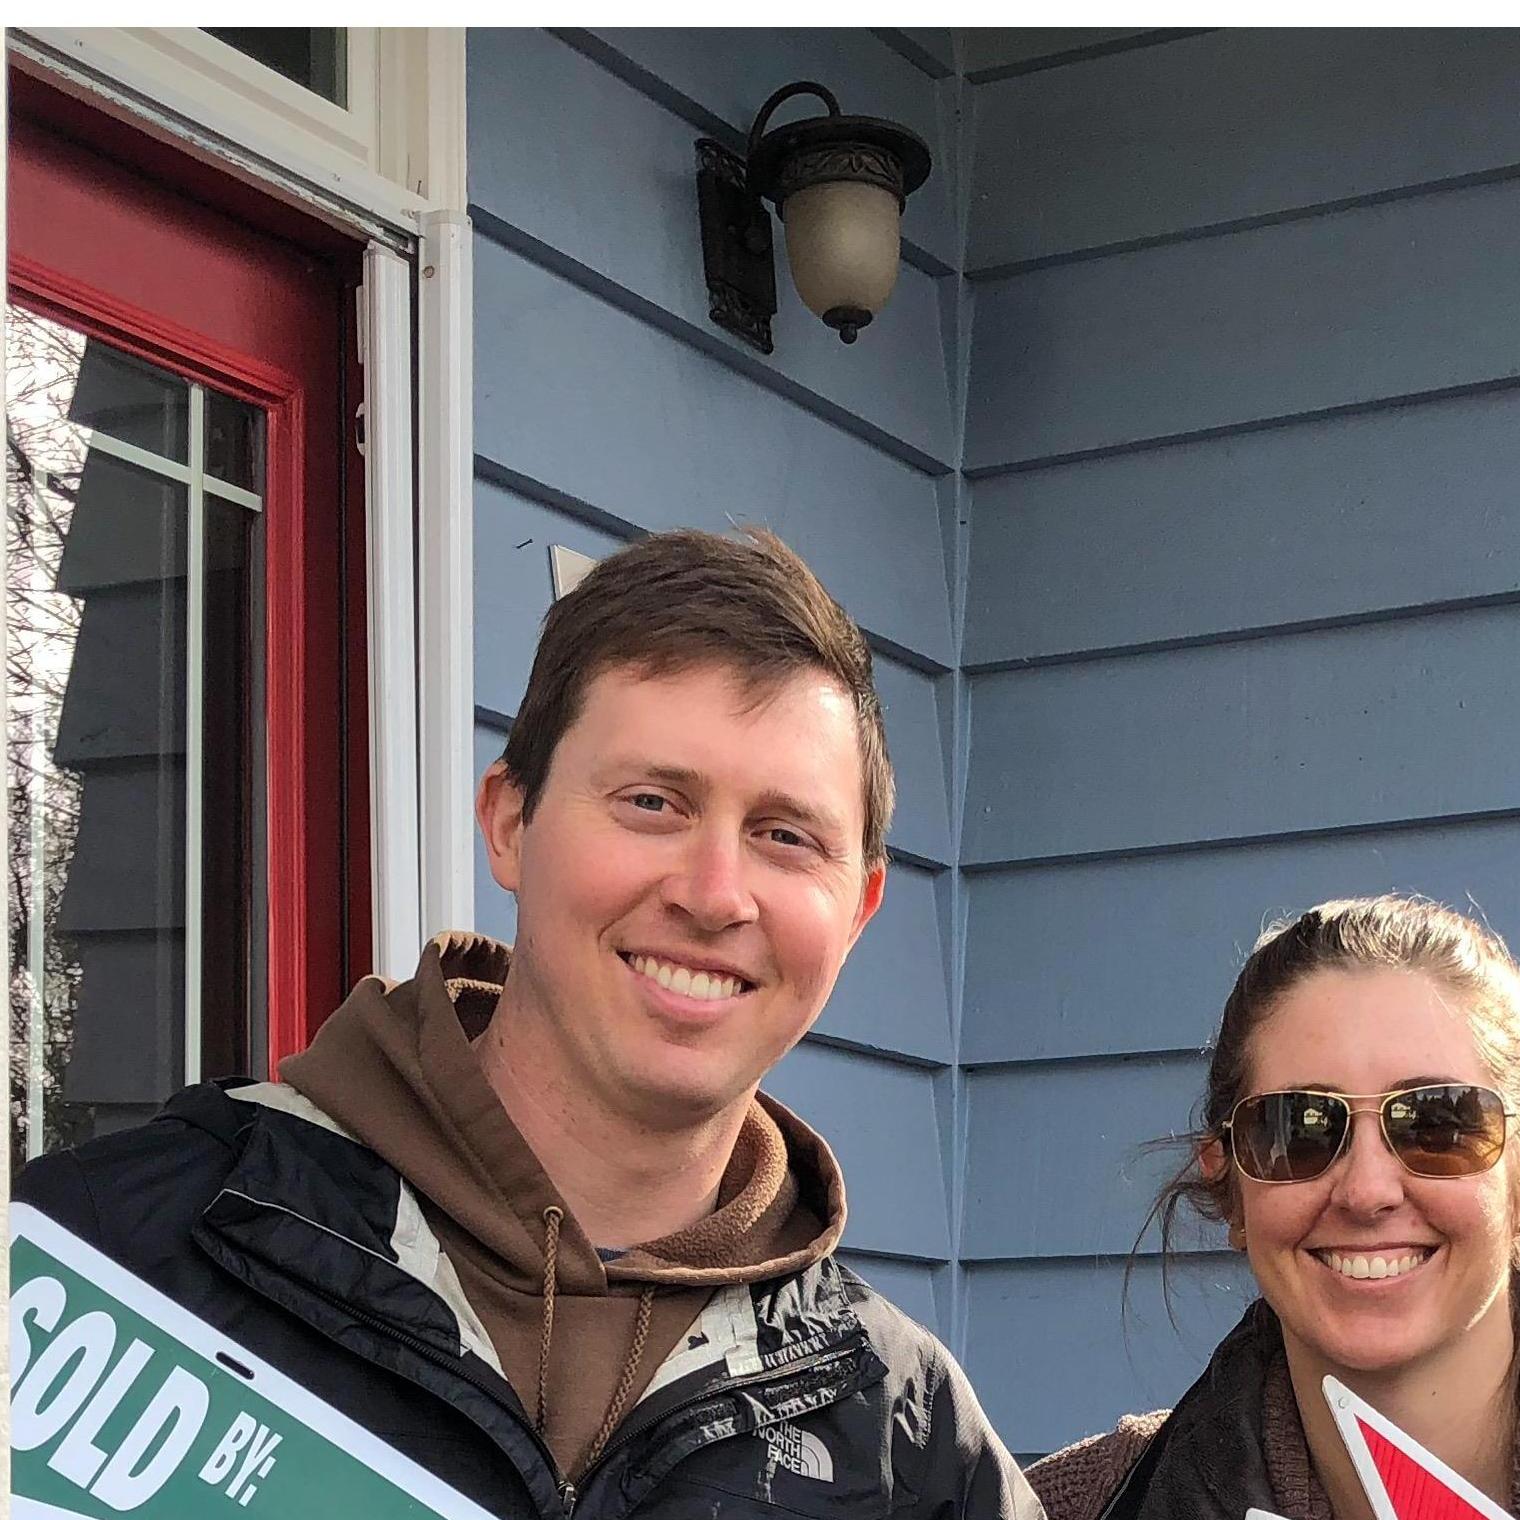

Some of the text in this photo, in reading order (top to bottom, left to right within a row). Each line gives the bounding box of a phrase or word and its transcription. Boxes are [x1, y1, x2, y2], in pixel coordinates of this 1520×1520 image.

[10, 1276, 283, 1511] SOLD BY:
[767, 1443, 801, 1475] FACE
